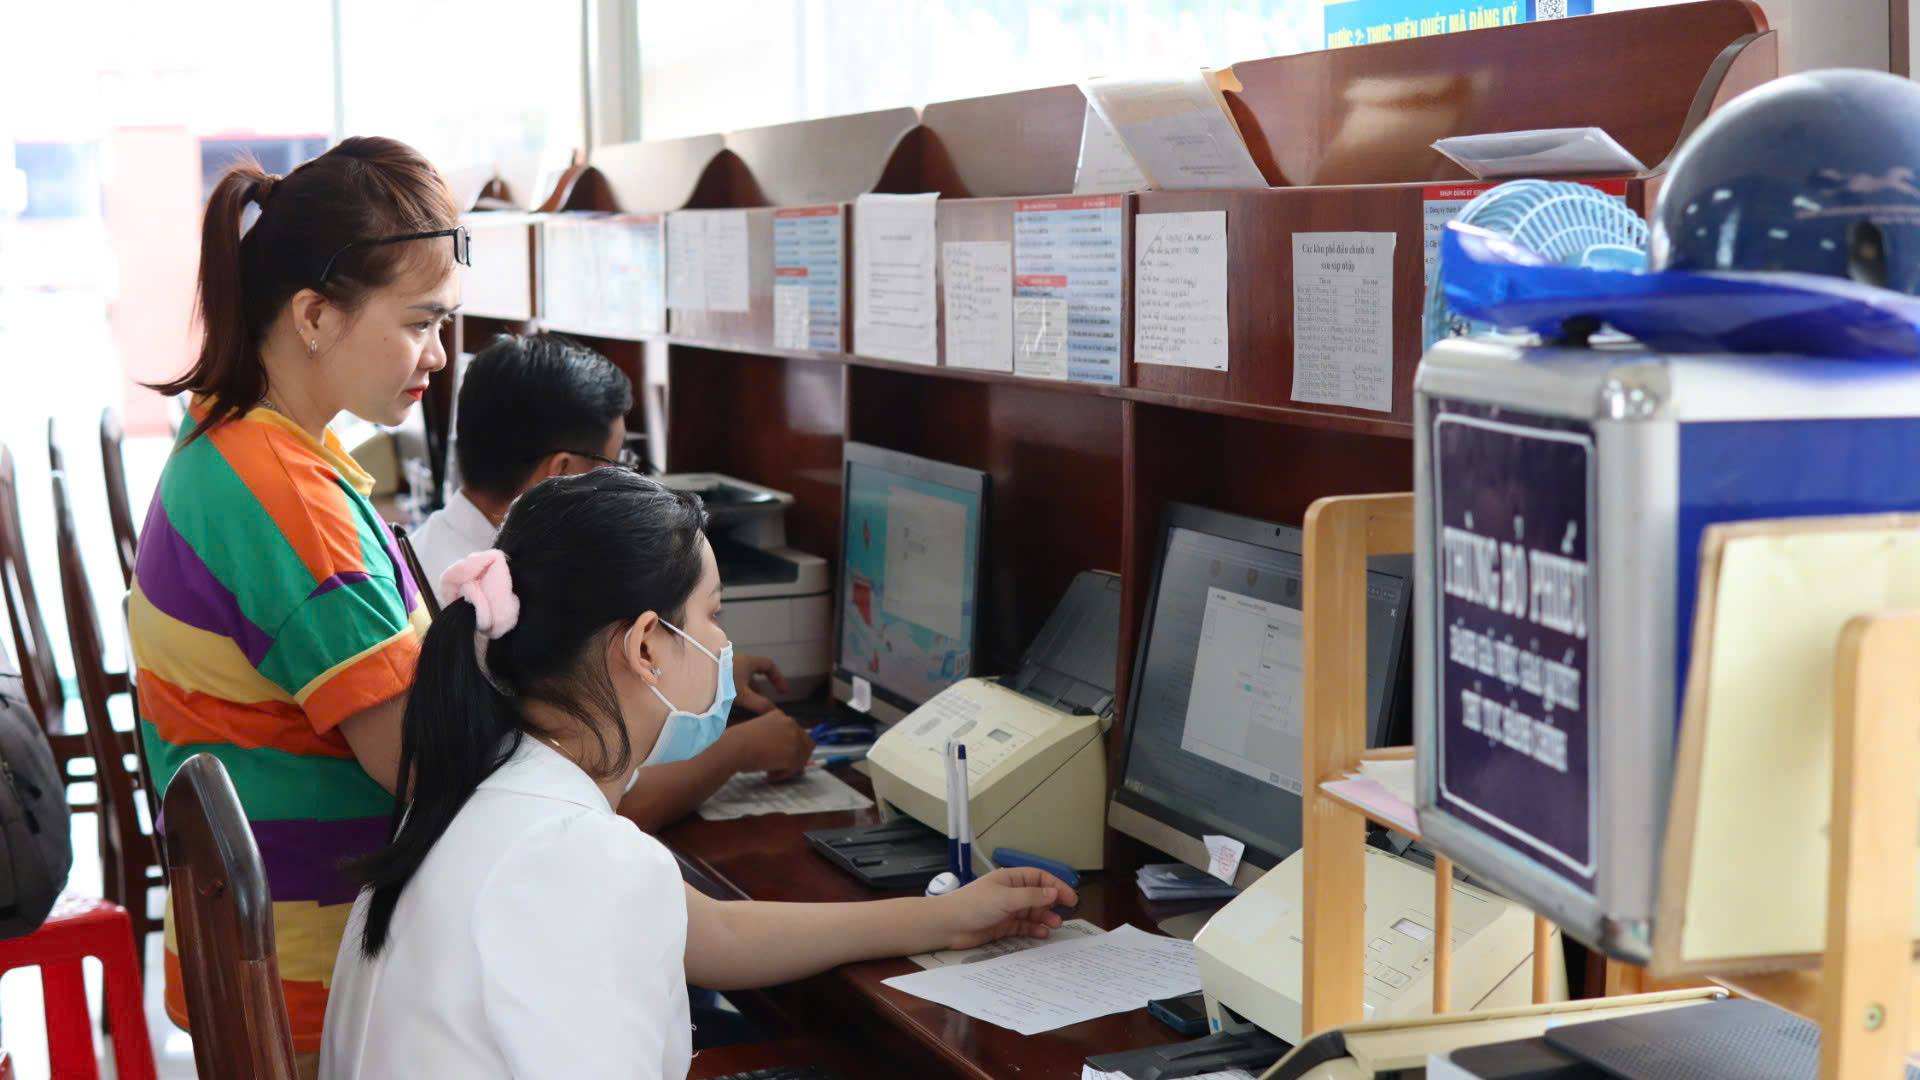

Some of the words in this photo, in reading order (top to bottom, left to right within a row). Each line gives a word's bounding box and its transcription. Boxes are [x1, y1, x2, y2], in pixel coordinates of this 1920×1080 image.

[1444, 511, 1499, 610] THÙNG
[1501, 515, 1527, 619] BỎ
[1530, 520, 1588, 639] PHIẾU
